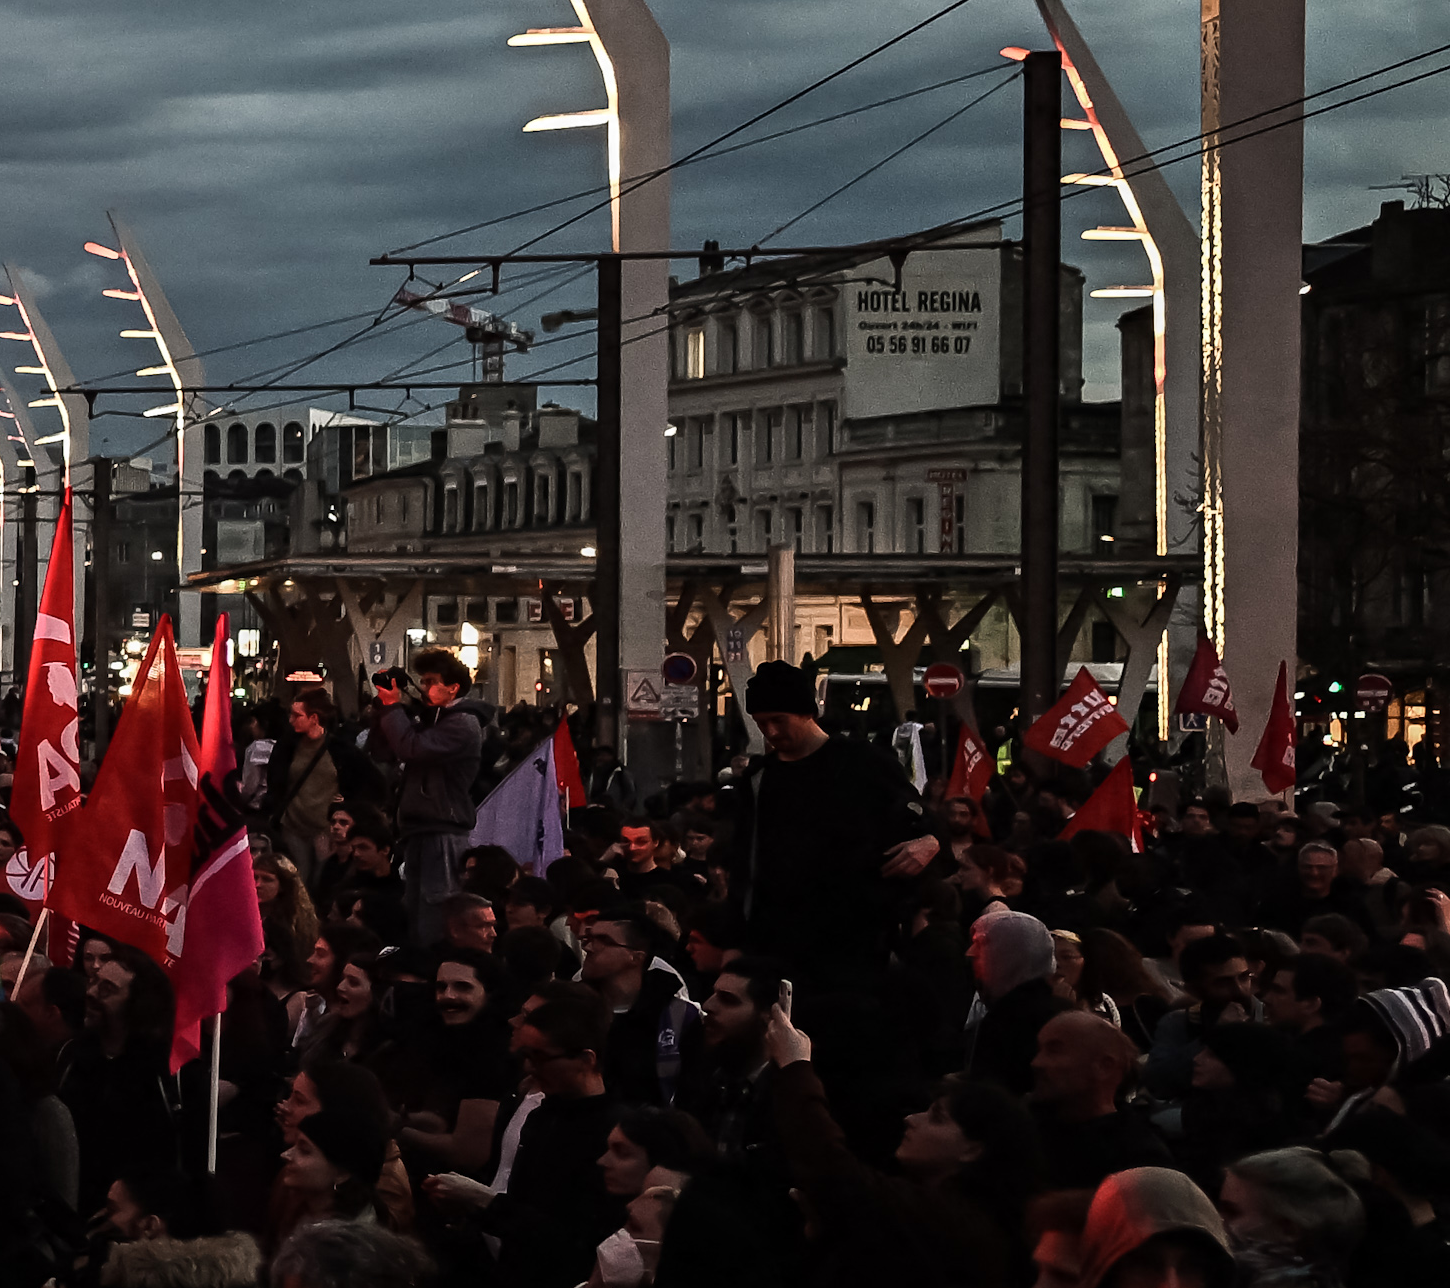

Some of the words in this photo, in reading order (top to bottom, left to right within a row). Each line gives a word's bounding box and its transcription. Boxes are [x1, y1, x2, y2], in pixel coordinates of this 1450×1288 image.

[858, 291, 909, 312] HOTEL
[918, 290, 981, 312] REGINA
[867, 336, 885, 354] 05
[890, 335, 907, 354] 56
[912, 336, 926, 354] 91
[932, 336, 949, 354] 66
[954, 336, 970, 354] 07
[99, 893, 145, 919] NOUVEAU
